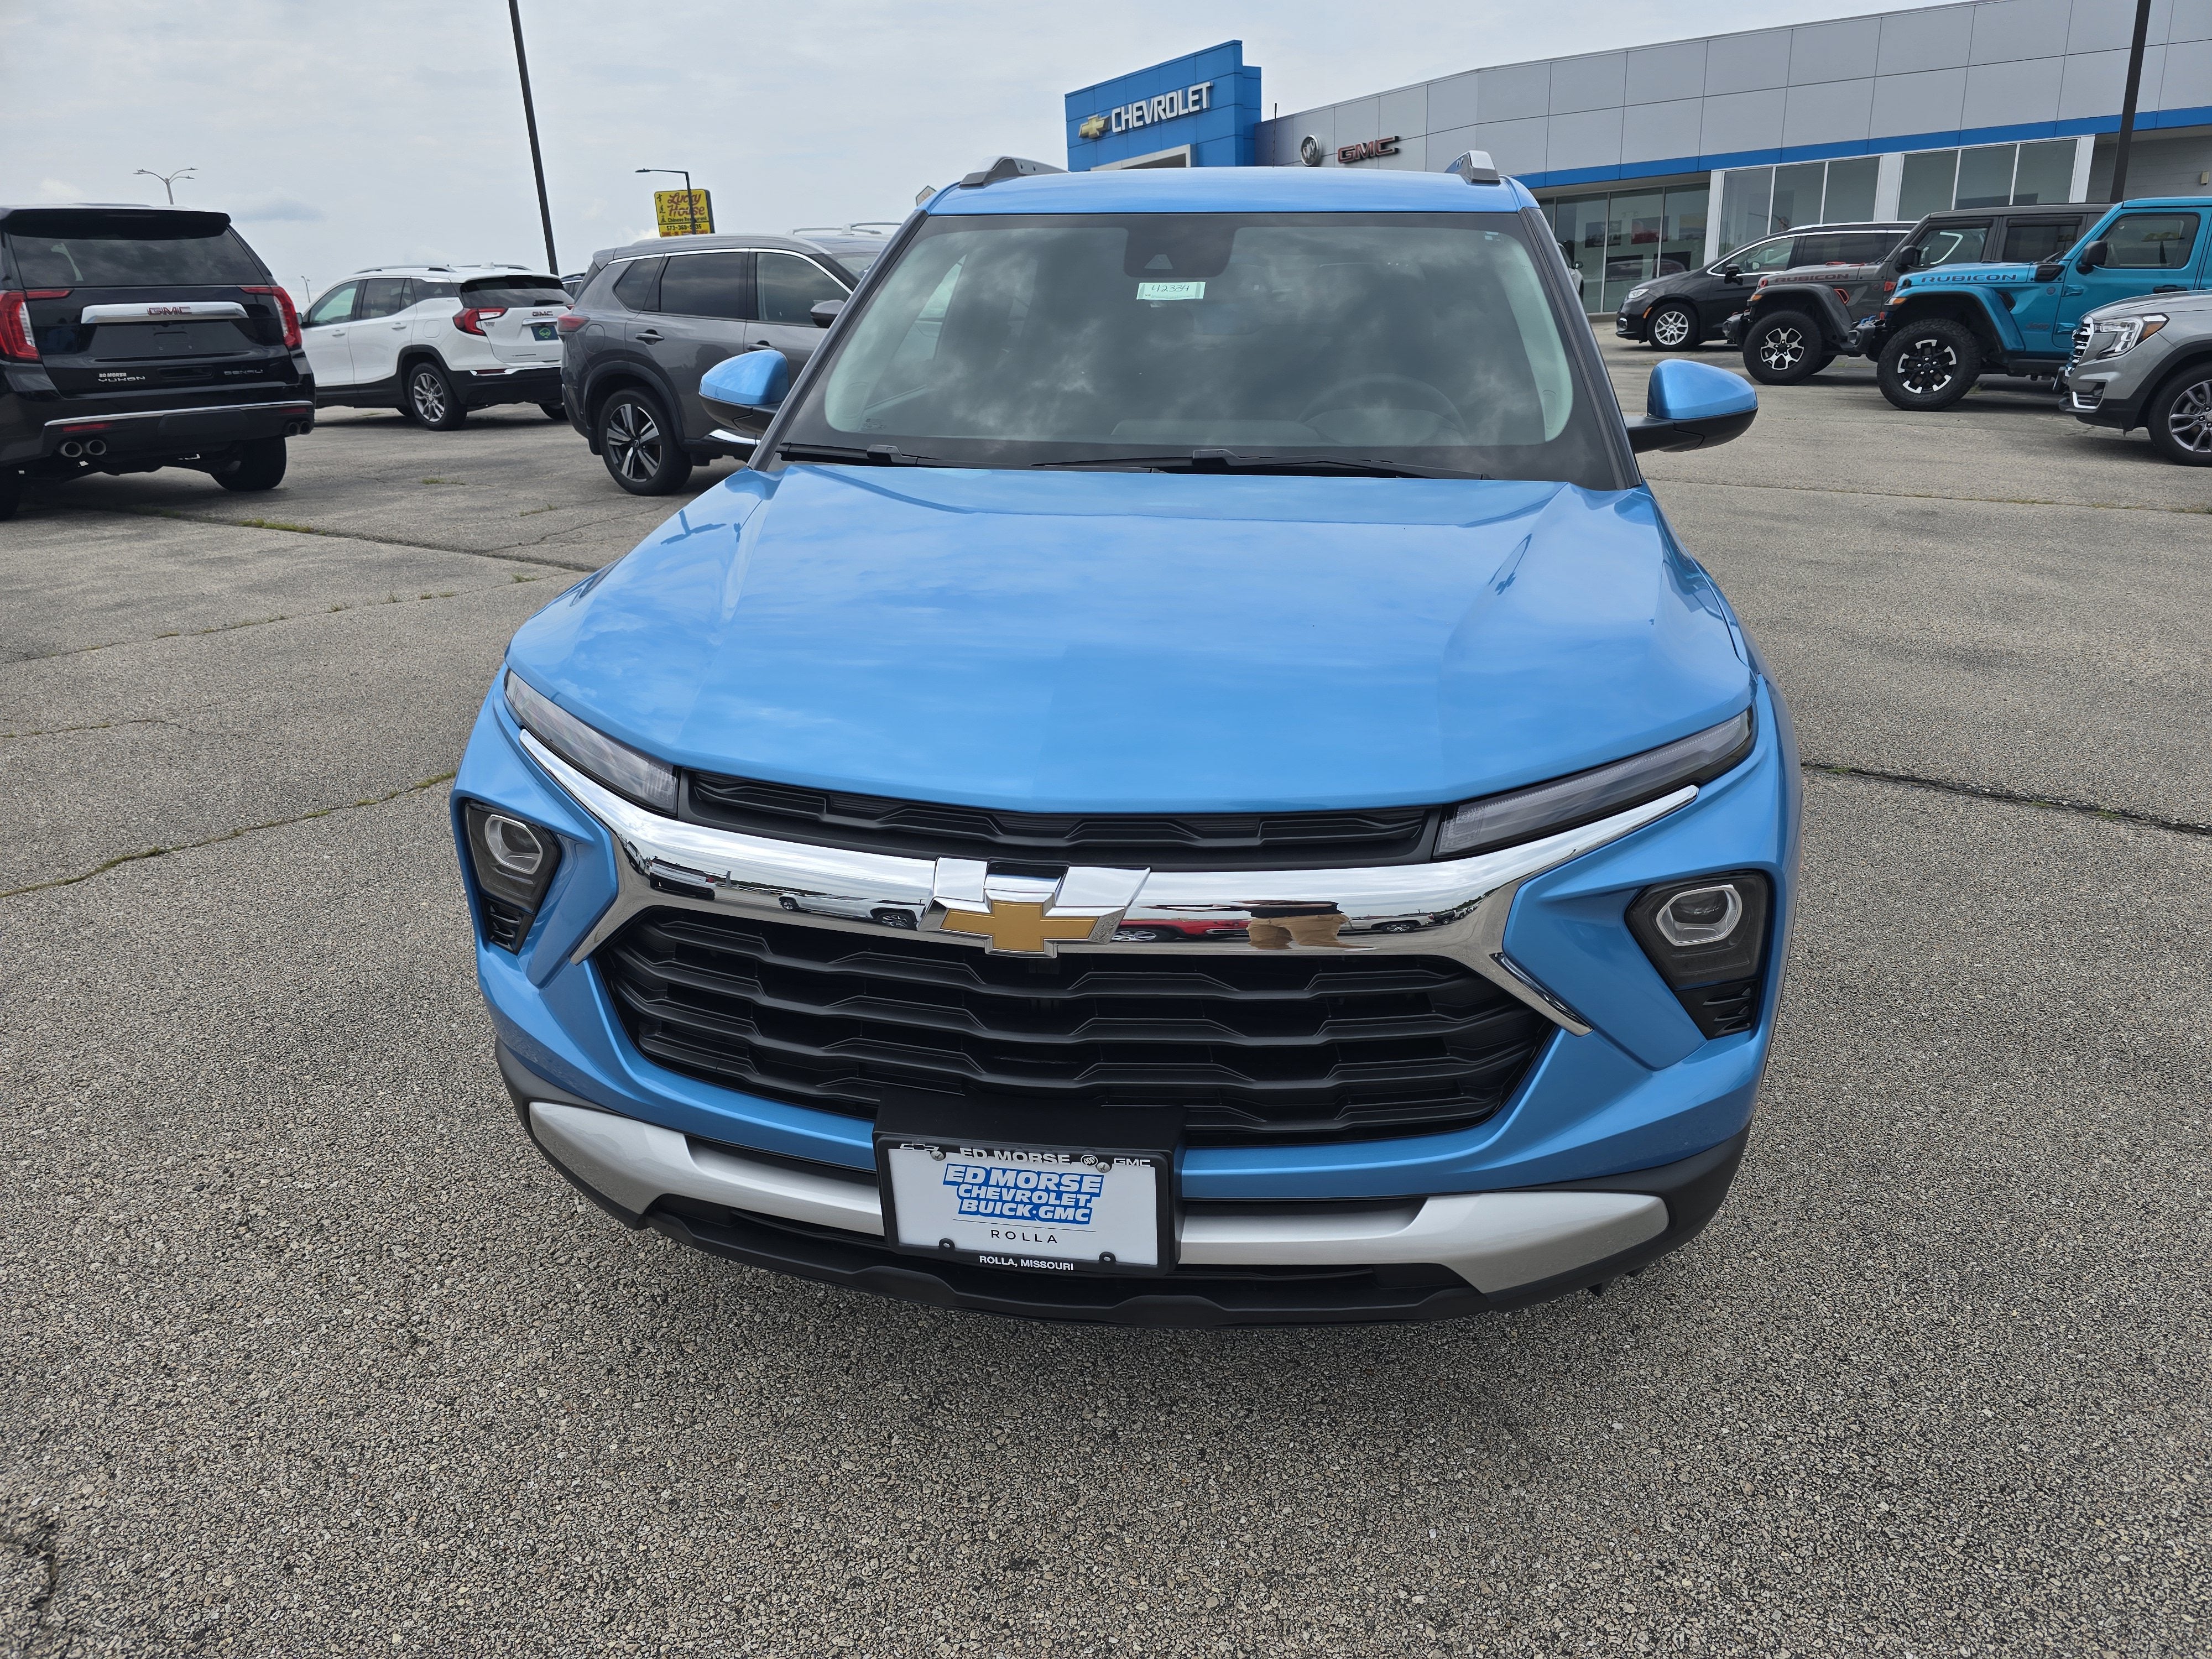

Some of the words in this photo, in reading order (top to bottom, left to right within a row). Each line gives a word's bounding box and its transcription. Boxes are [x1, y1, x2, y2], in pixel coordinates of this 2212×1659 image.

[1112, 81, 1212, 133] CHEVROLET
[1338, 137, 1397, 164] GMC
[667, 192, 701, 205] Lucy
[1774, 274, 1849, 283] RUBICON
[1921, 274, 2017, 283] RUBICON
[147, 306, 192, 316] GMC
[959, 1147, 988, 1160] ED
[994, 1150, 1070, 1165] MORSE
[1113, 1157, 1151, 1167] GMC
[945, 1165, 986, 1184] ED
[989, 1168, 1102, 1193] MORSE
[958, 1185, 1090, 1207] CHEVROLET
[991, 1229, 1057, 1244] ROLLA
[979, 1255, 1018, 1267] ROLLA,
[1020, 1259, 1073, 1271] MISSOURI
